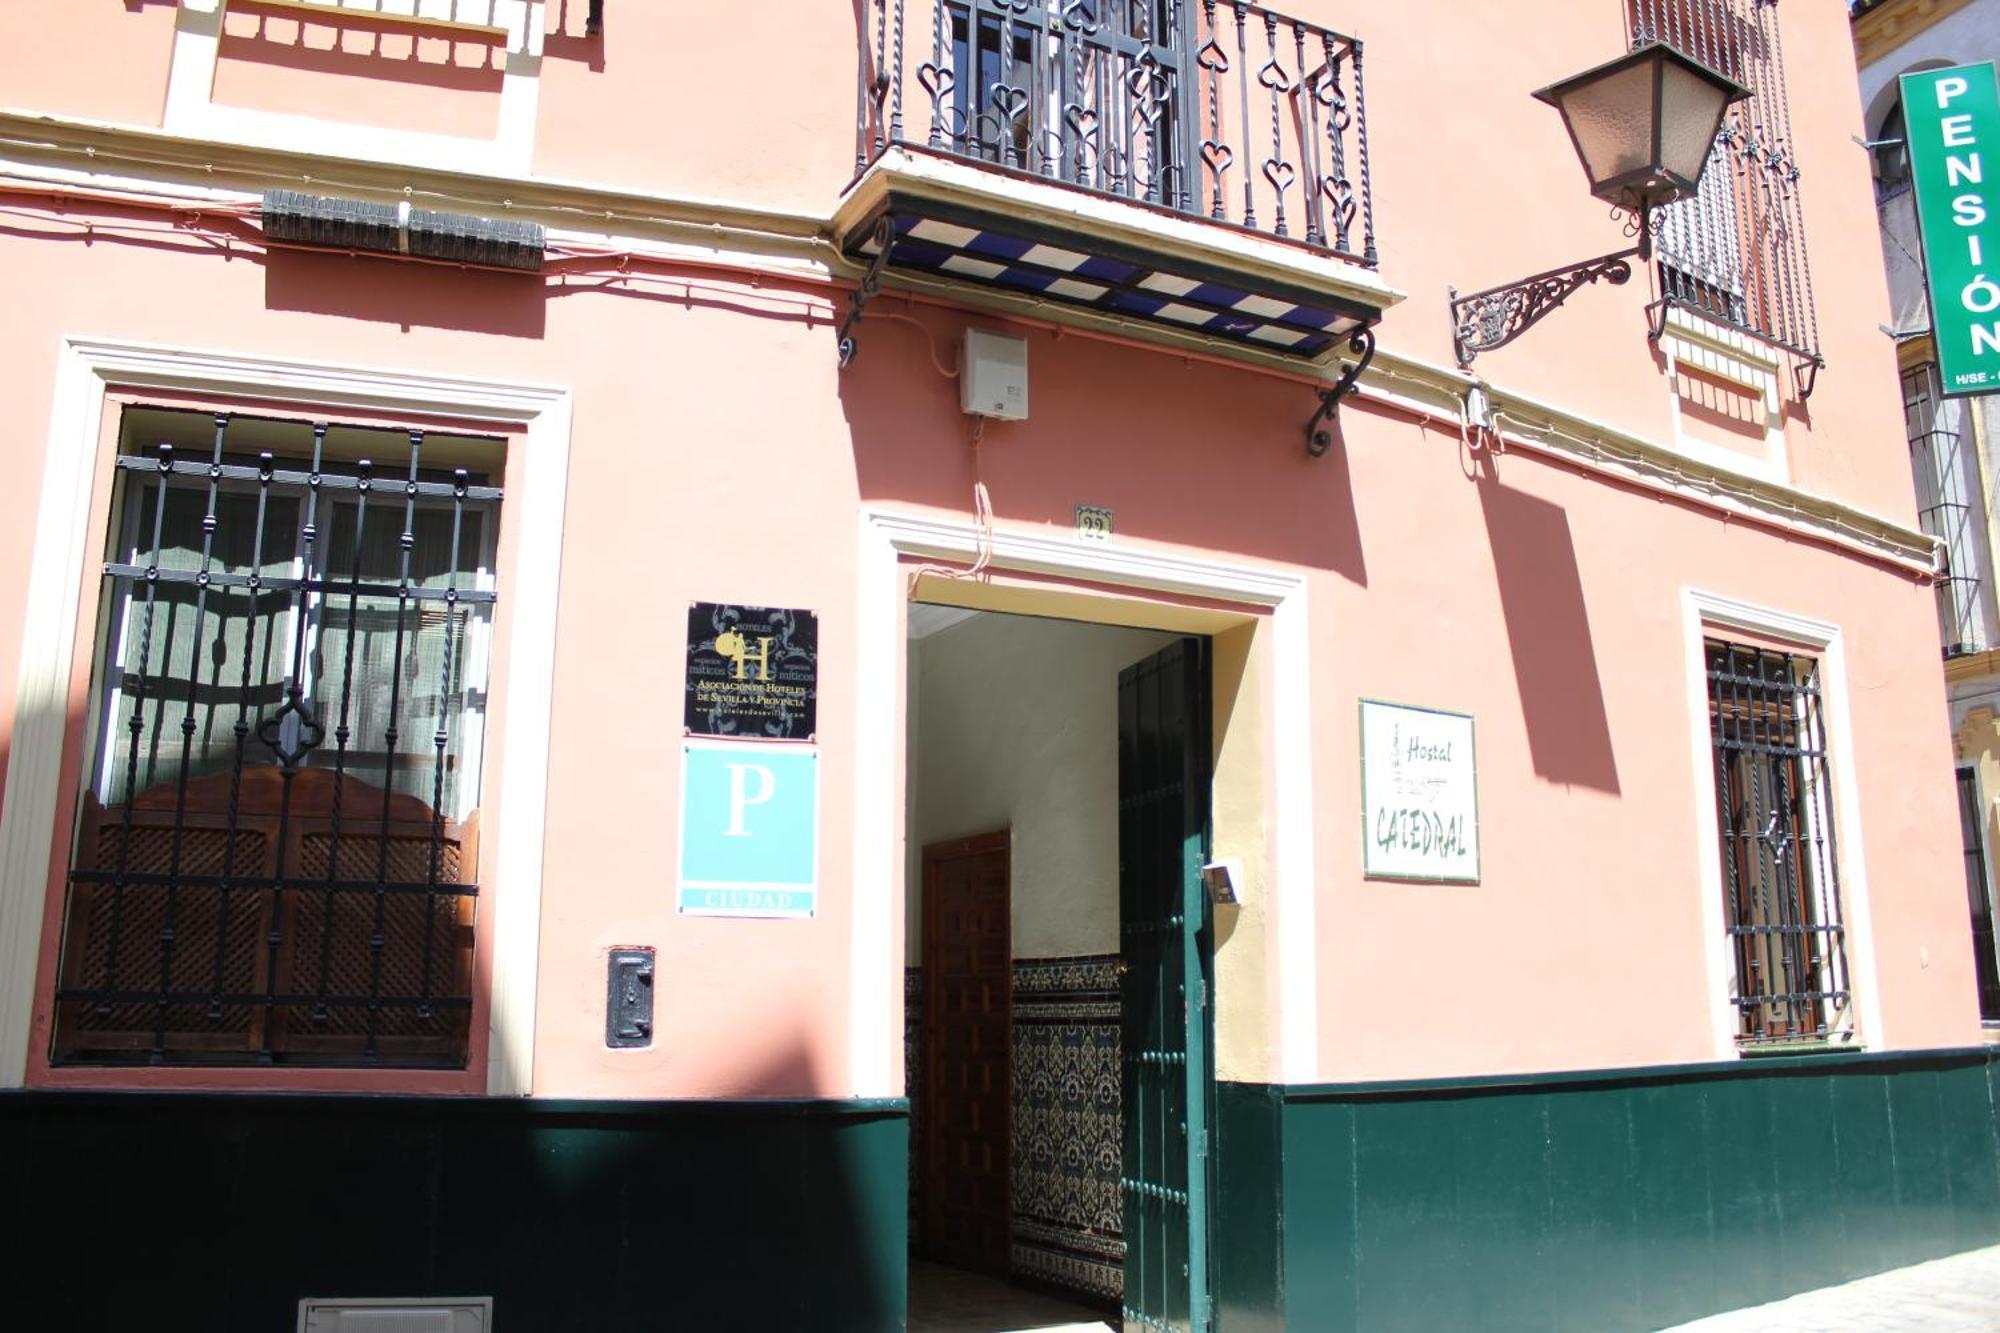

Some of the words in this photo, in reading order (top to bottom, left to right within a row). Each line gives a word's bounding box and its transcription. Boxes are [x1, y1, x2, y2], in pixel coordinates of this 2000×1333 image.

[1935, 77, 2000, 356] PENSIÓN
[1083, 516, 1104, 540] 22
[710, 693, 747, 704] SEVILLA
[756, 695, 805, 707] PROVINCIA
[766, 684, 807, 695] HOTELES
[1407, 735, 1452, 763] Hostal
[721, 763, 776, 837] P
[1377, 806, 1467, 860] CATEDRAL
[704, 891, 793, 909] CIUDAD
